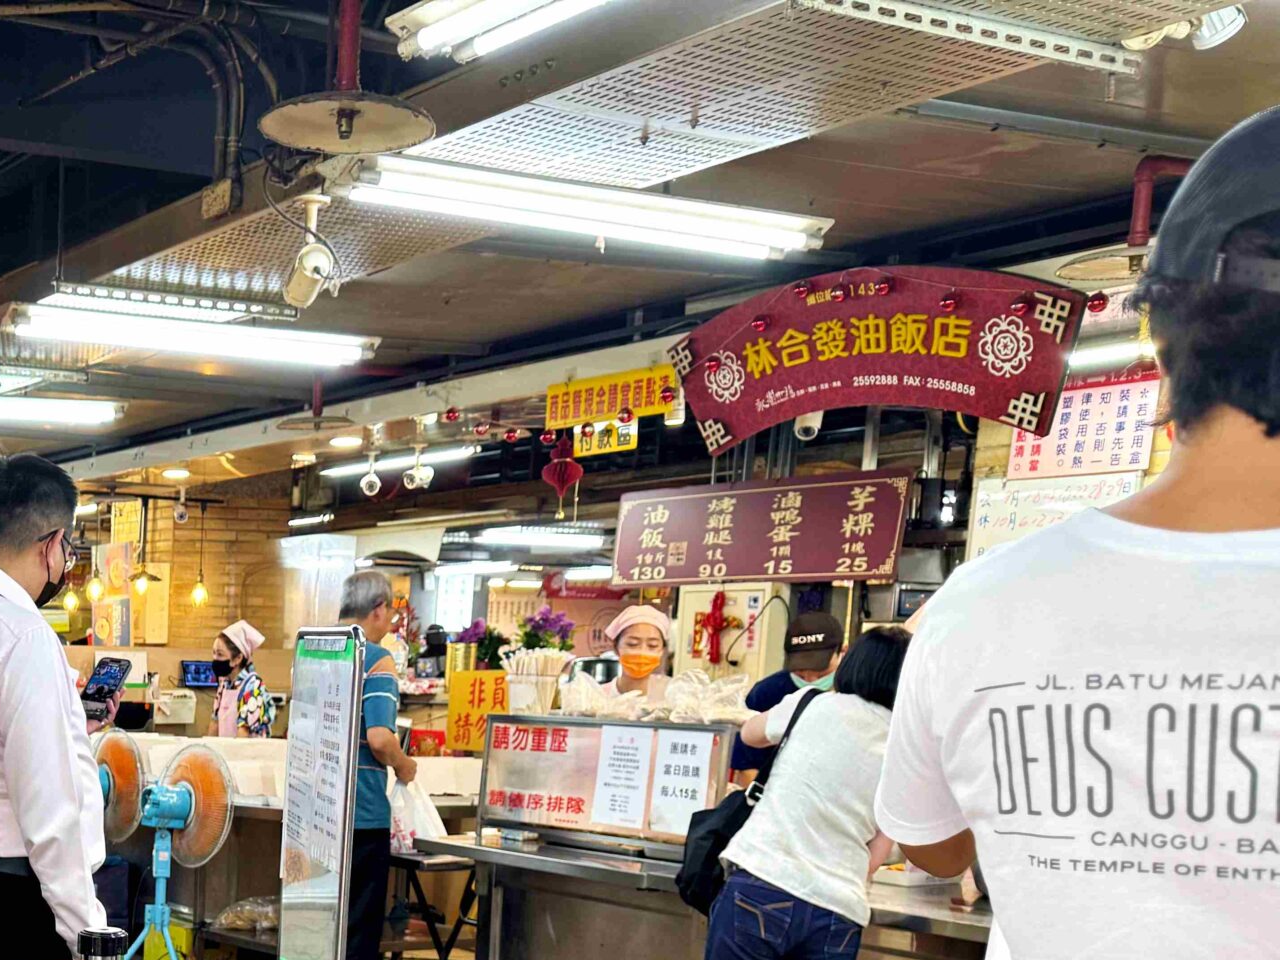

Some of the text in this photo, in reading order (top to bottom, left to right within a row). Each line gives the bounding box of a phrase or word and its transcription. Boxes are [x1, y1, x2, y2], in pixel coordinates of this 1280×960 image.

[849, 282, 875, 298] 143
[742, 312, 973, 380] 林合發油飯店
[852, 375, 898, 387] 25592888
[1071, 392, 1093, 469] 律使用耐熱
[1109, 389, 1132, 466] 裝請事先告
[702, 497, 737, 546] 烤雞腿
[766, 491, 803, 543] 滷鴨蛋
[840, 485, 877, 539] 芋粿
[638, 504, 670, 549] 油飯
[629, 566, 666, 581] 130
[698, 563, 727, 578] 90
[763, 560, 794, 575] 15
[835, 556, 869, 573] 25
[791, 633, 825, 645] SONY
[1035, 674, 1075, 691] JL.
[1084, 673, 1169, 691] BATU
[492, 724, 569, 753] 請勿重壓
[988, 702, 1114, 818] DEUS
[487, 789, 586, 815] 請依序排隊
[1090, 830, 1209, 851] CANGGU
[1028, 854, 1061, 870] THE
[1069, 859, 1166, 875] TEMPLE
[1174, 863, 1207, 877] OF
